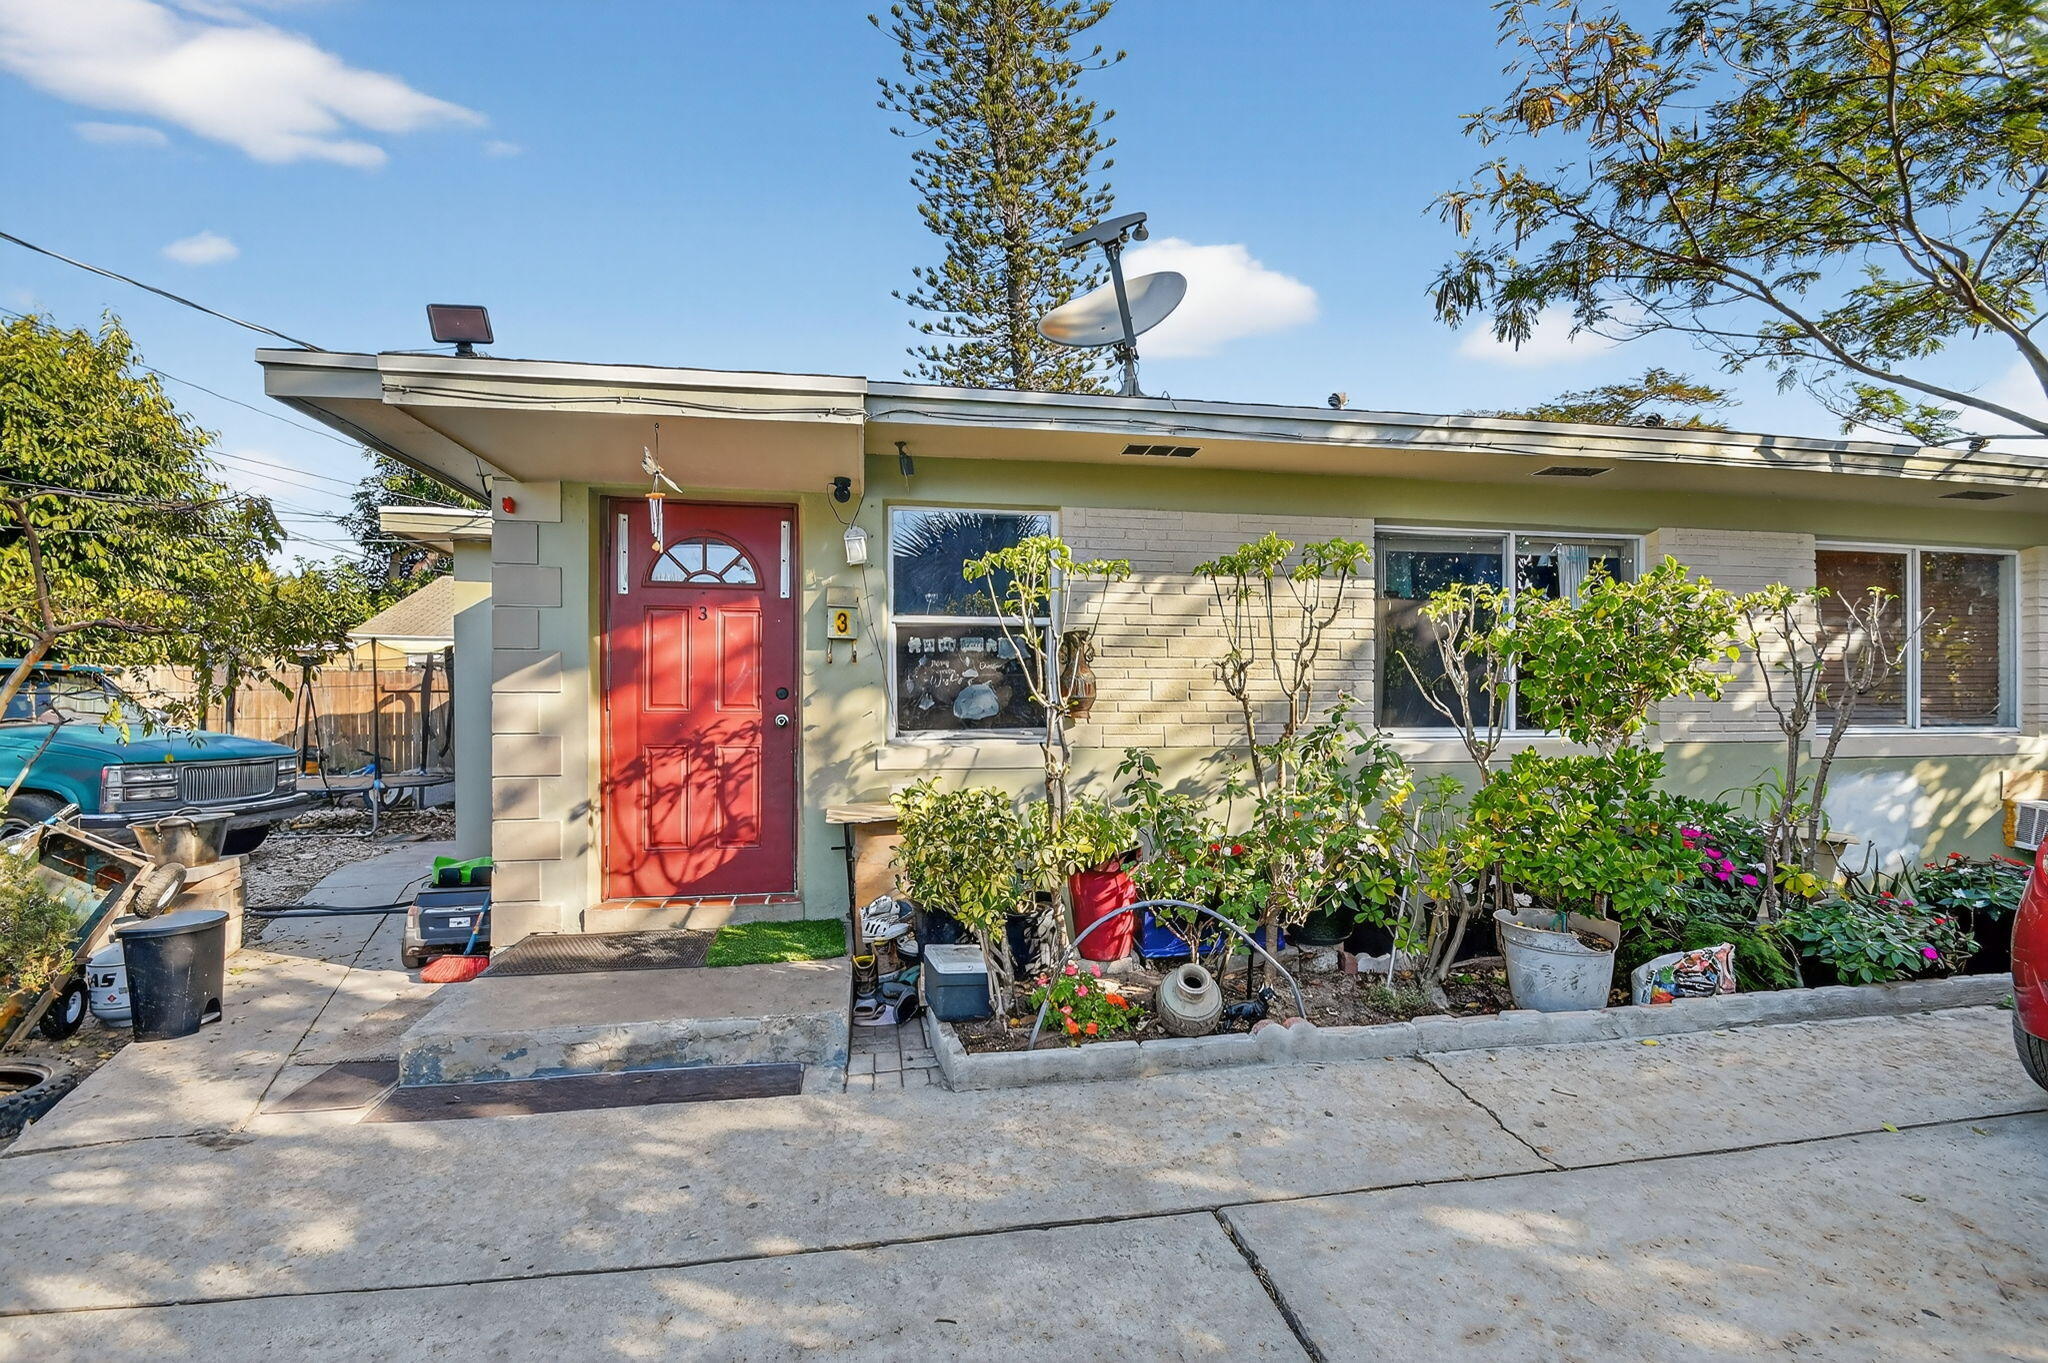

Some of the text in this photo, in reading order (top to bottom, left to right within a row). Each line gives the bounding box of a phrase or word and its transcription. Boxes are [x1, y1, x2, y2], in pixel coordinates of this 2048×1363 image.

[697, 606, 708, 621] 3
[836, 612, 848, 633] 3
[87, 972, 117, 988] AS
